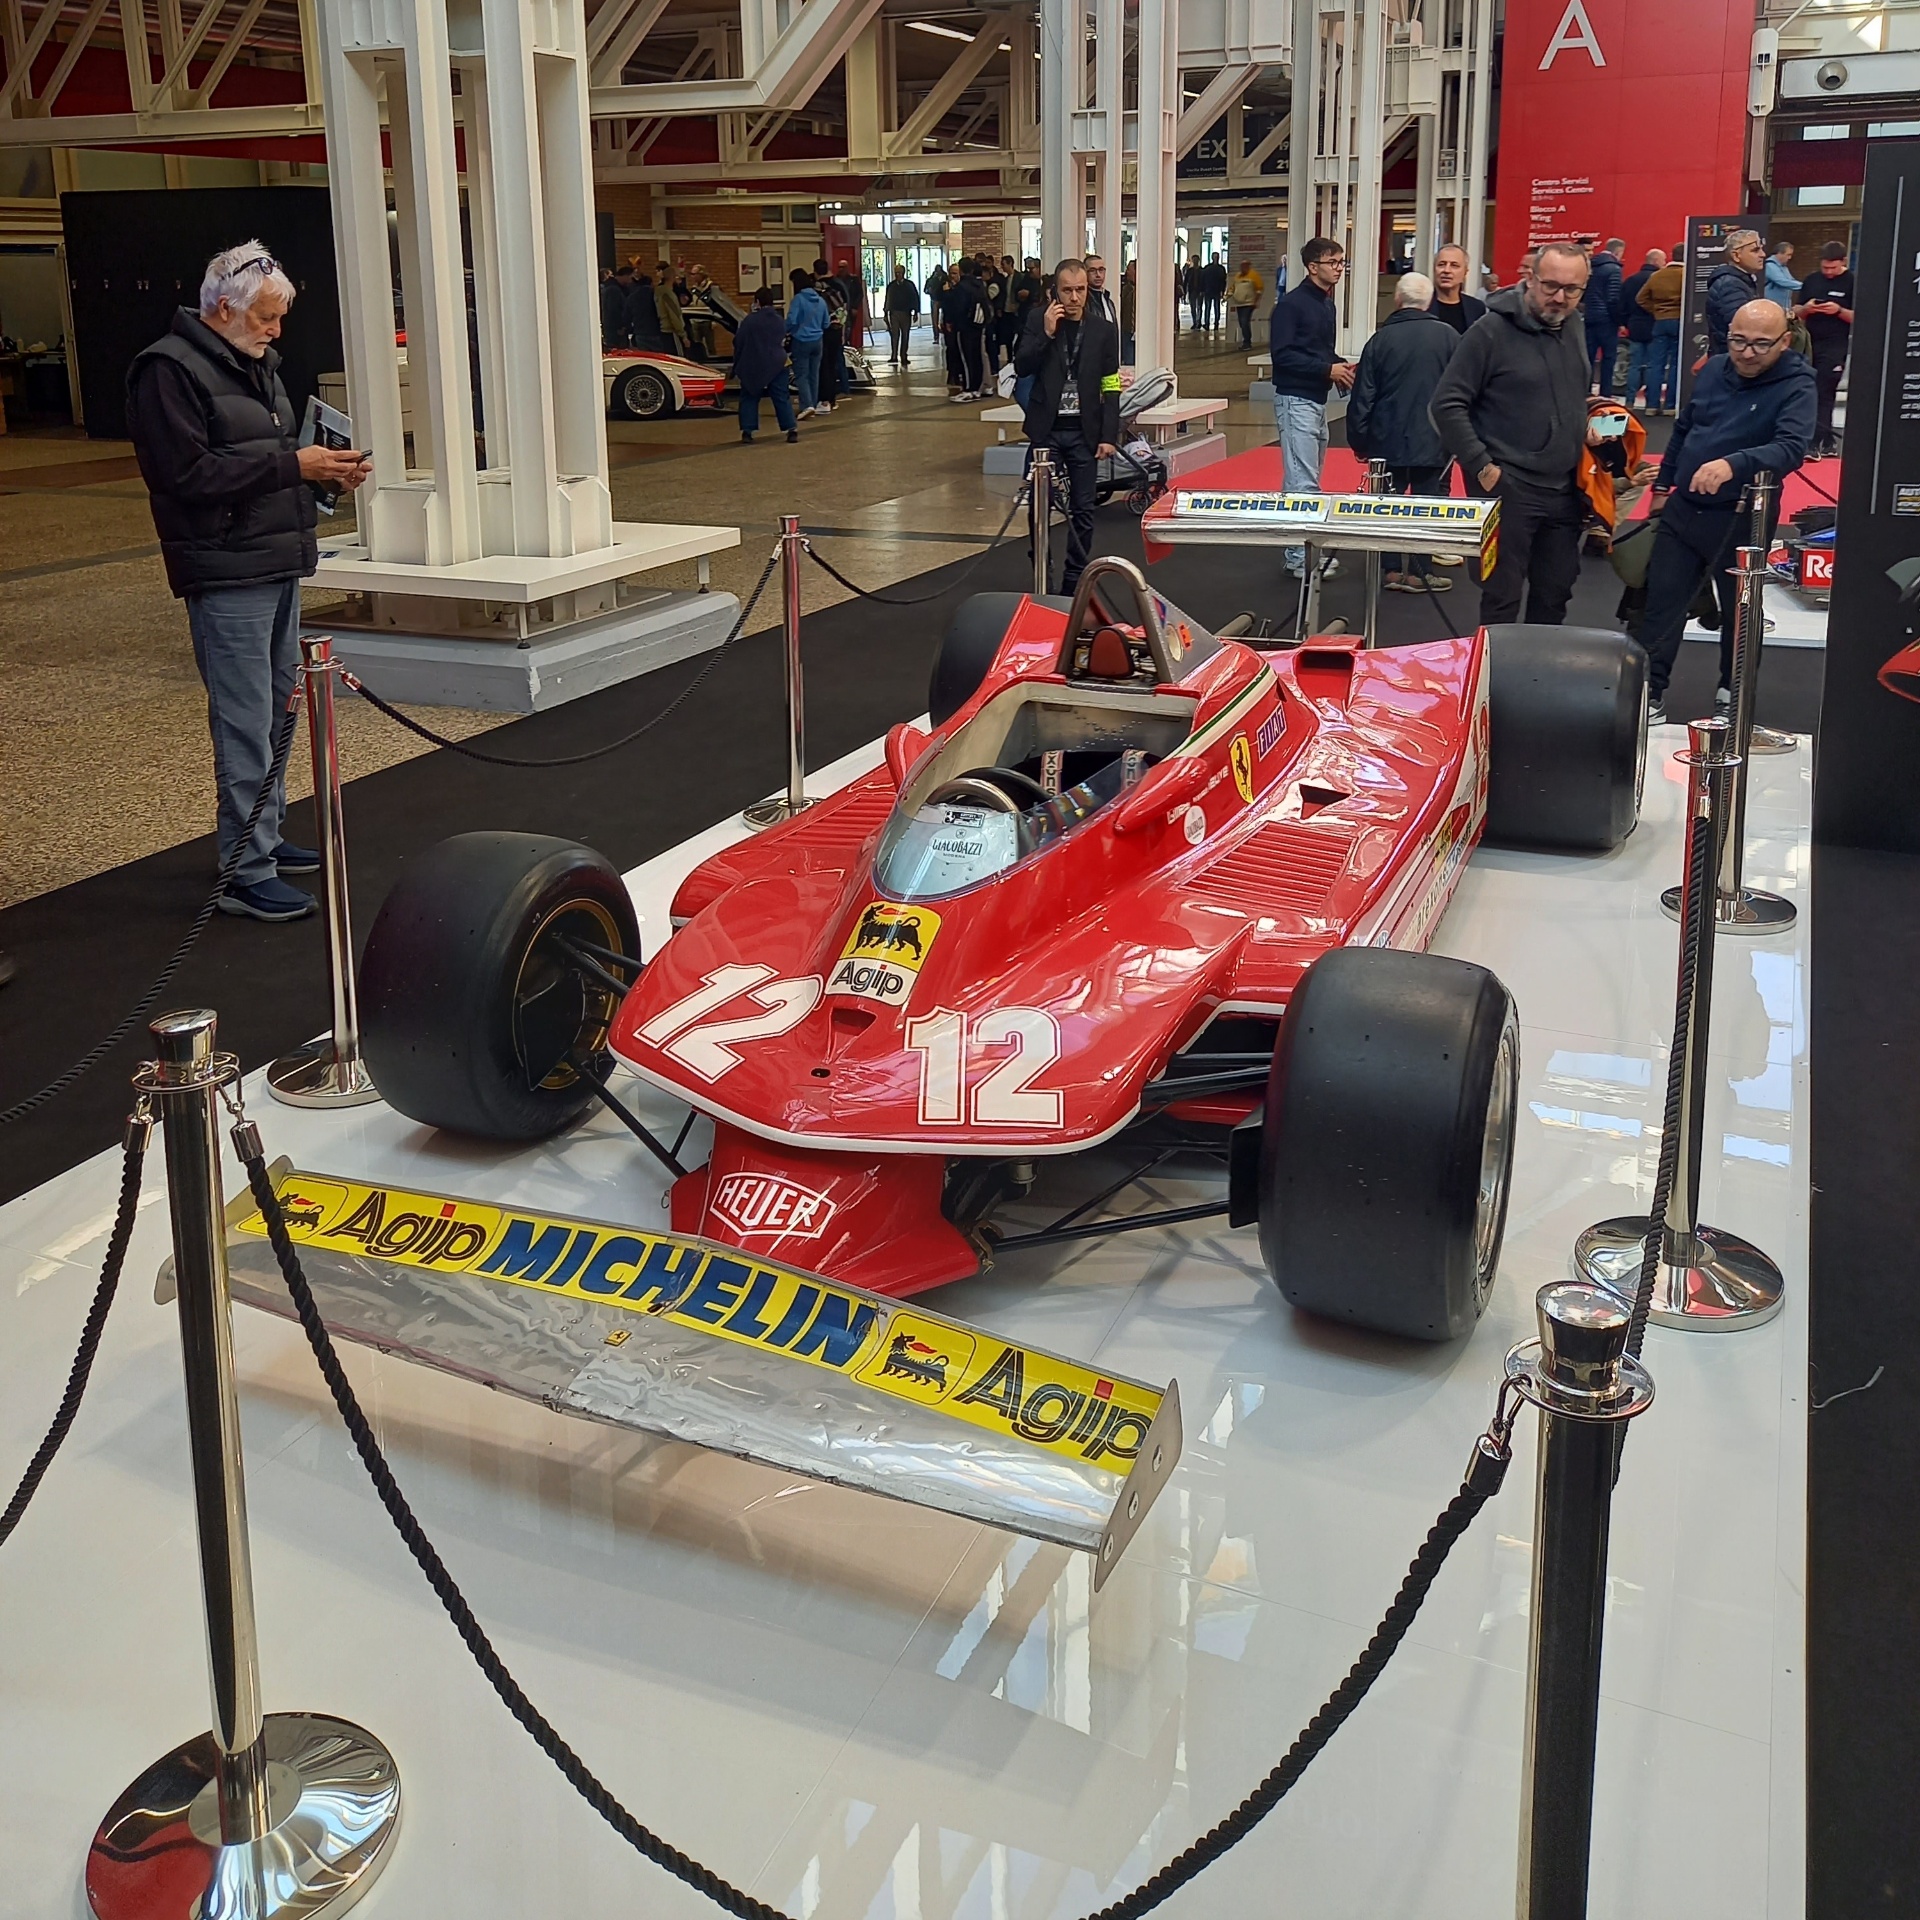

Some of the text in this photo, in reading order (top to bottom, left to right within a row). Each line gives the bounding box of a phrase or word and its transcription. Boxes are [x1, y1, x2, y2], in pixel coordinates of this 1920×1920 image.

[1538, 0, 1606, 70] A
[1190, 498, 1319, 513] MICHELIN
[1338, 502, 1476, 519] MICHELIN
[1259, 707, 1285, 756] FIAT
[932, 839, 983, 856] GIACOBAZZI
[831, 961, 904, 997] Agip
[633, 962, 824, 1084] 12
[904, 1004, 1065, 1129] 12
[718, 1176, 816, 1229] HEUER
[321, 1190, 1154, 1461] Agip MICHELIN Agip
